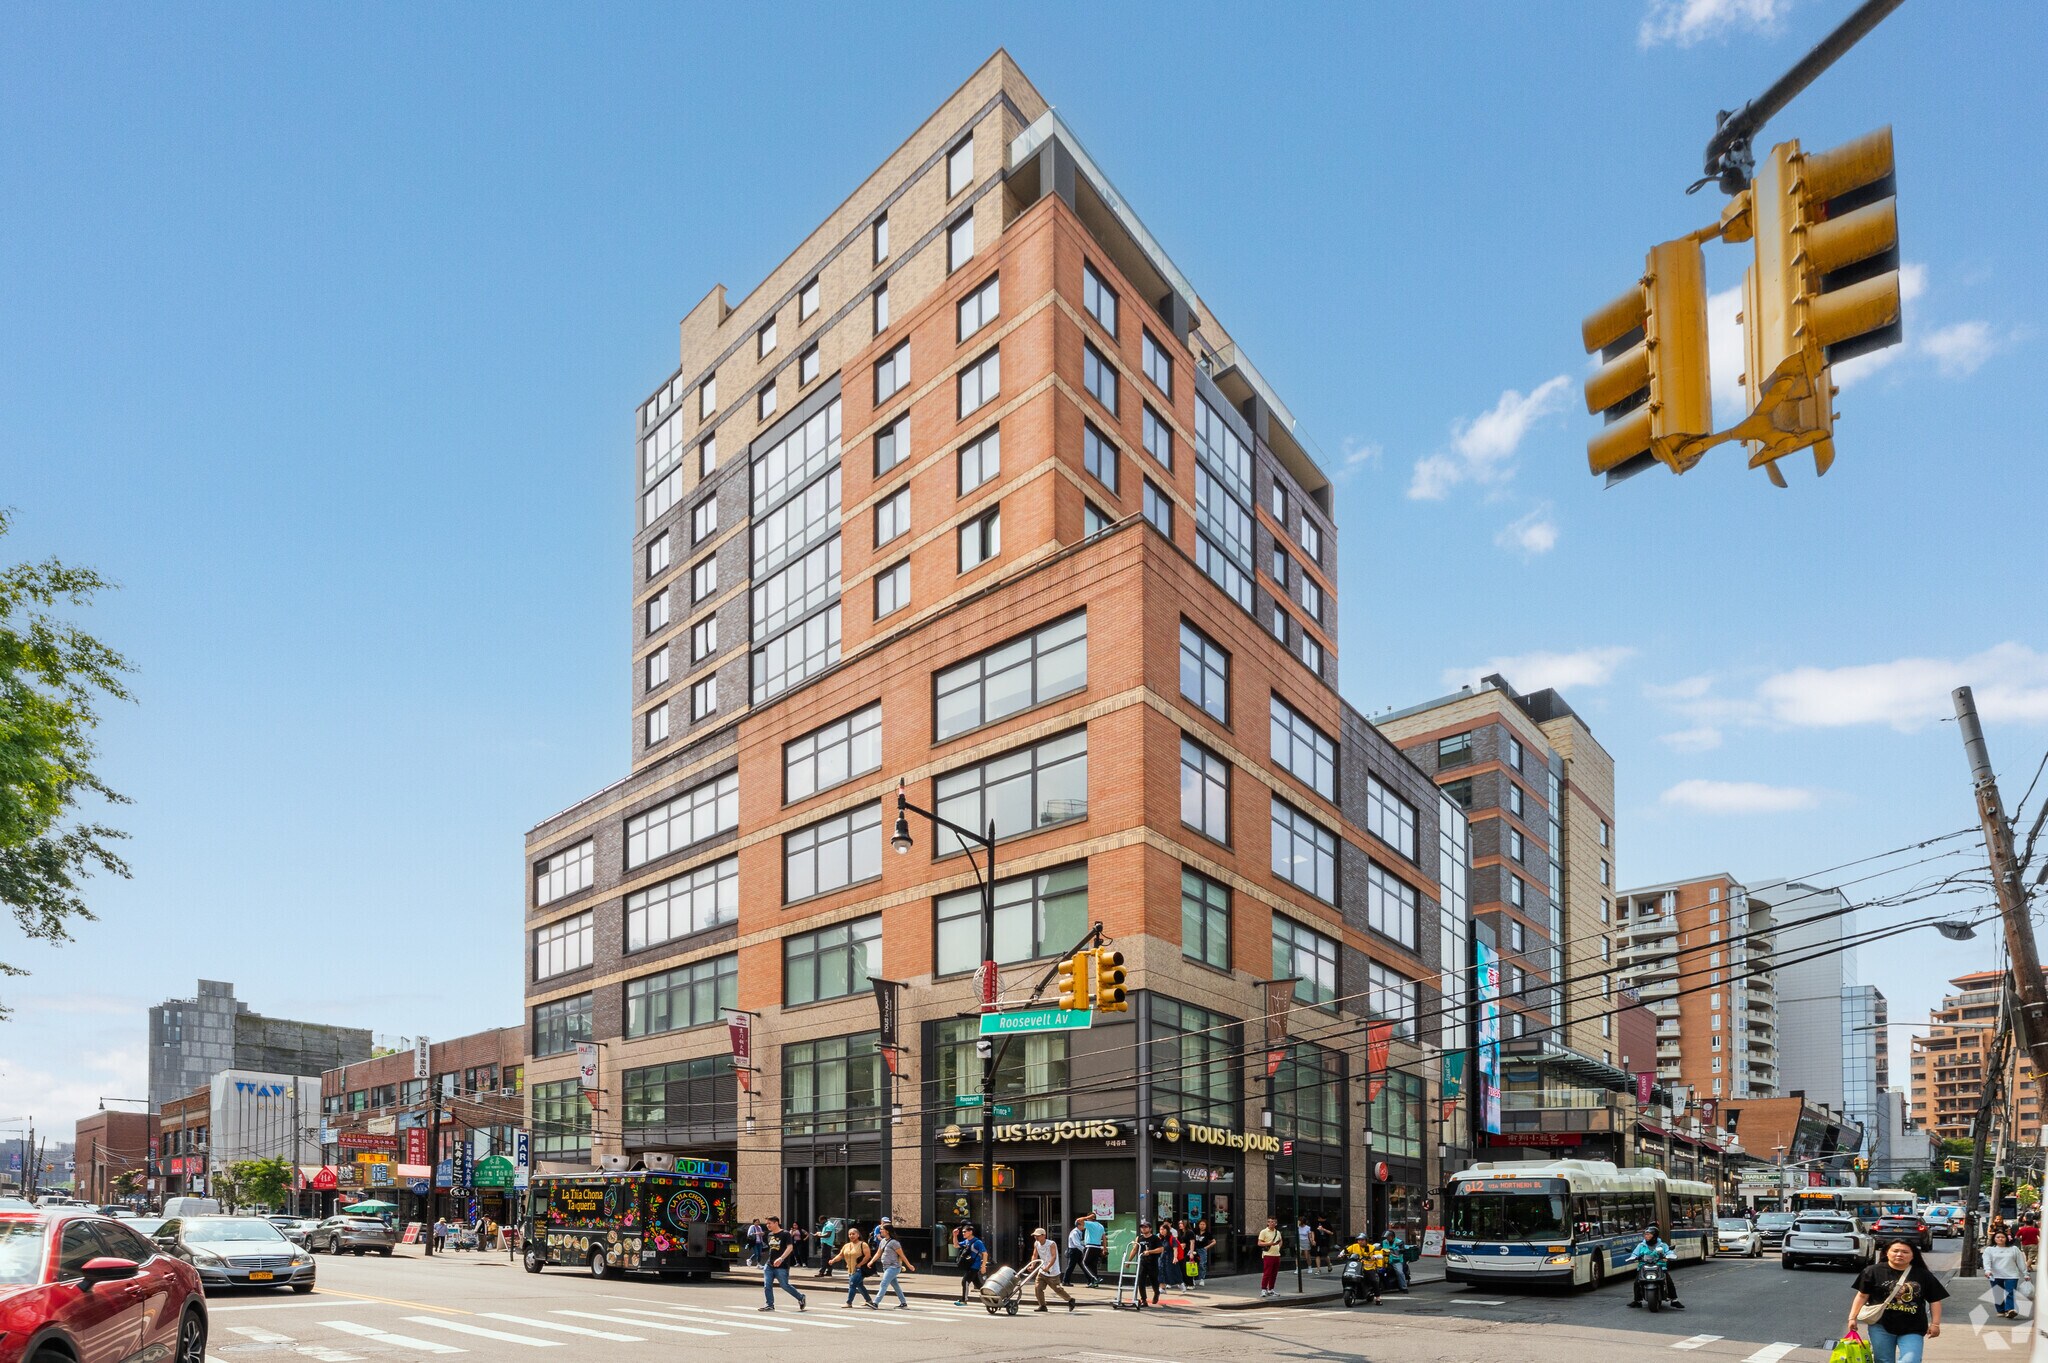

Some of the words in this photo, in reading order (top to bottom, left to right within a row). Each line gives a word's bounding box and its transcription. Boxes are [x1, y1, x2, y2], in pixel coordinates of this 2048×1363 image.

[999, 1014, 1051, 1029] Roosevelt
[1055, 1013, 1068, 1024] Av
[993, 1106, 1007, 1115] Prince
[1026, 1123, 1051, 1141] les
[1051, 1119, 1119, 1144] JOURS
[1188, 1124, 1226, 1146] TOUS
[1225, 1129, 1244, 1148] les
[1242, 1132, 1280, 1152] JOURS
[562, 1189, 570, 1199] La
[583, 1189, 603, 1199] Chona
[670, 1200, 678, 1208] LA
[688, 1193, 706, 1210] CHONA
